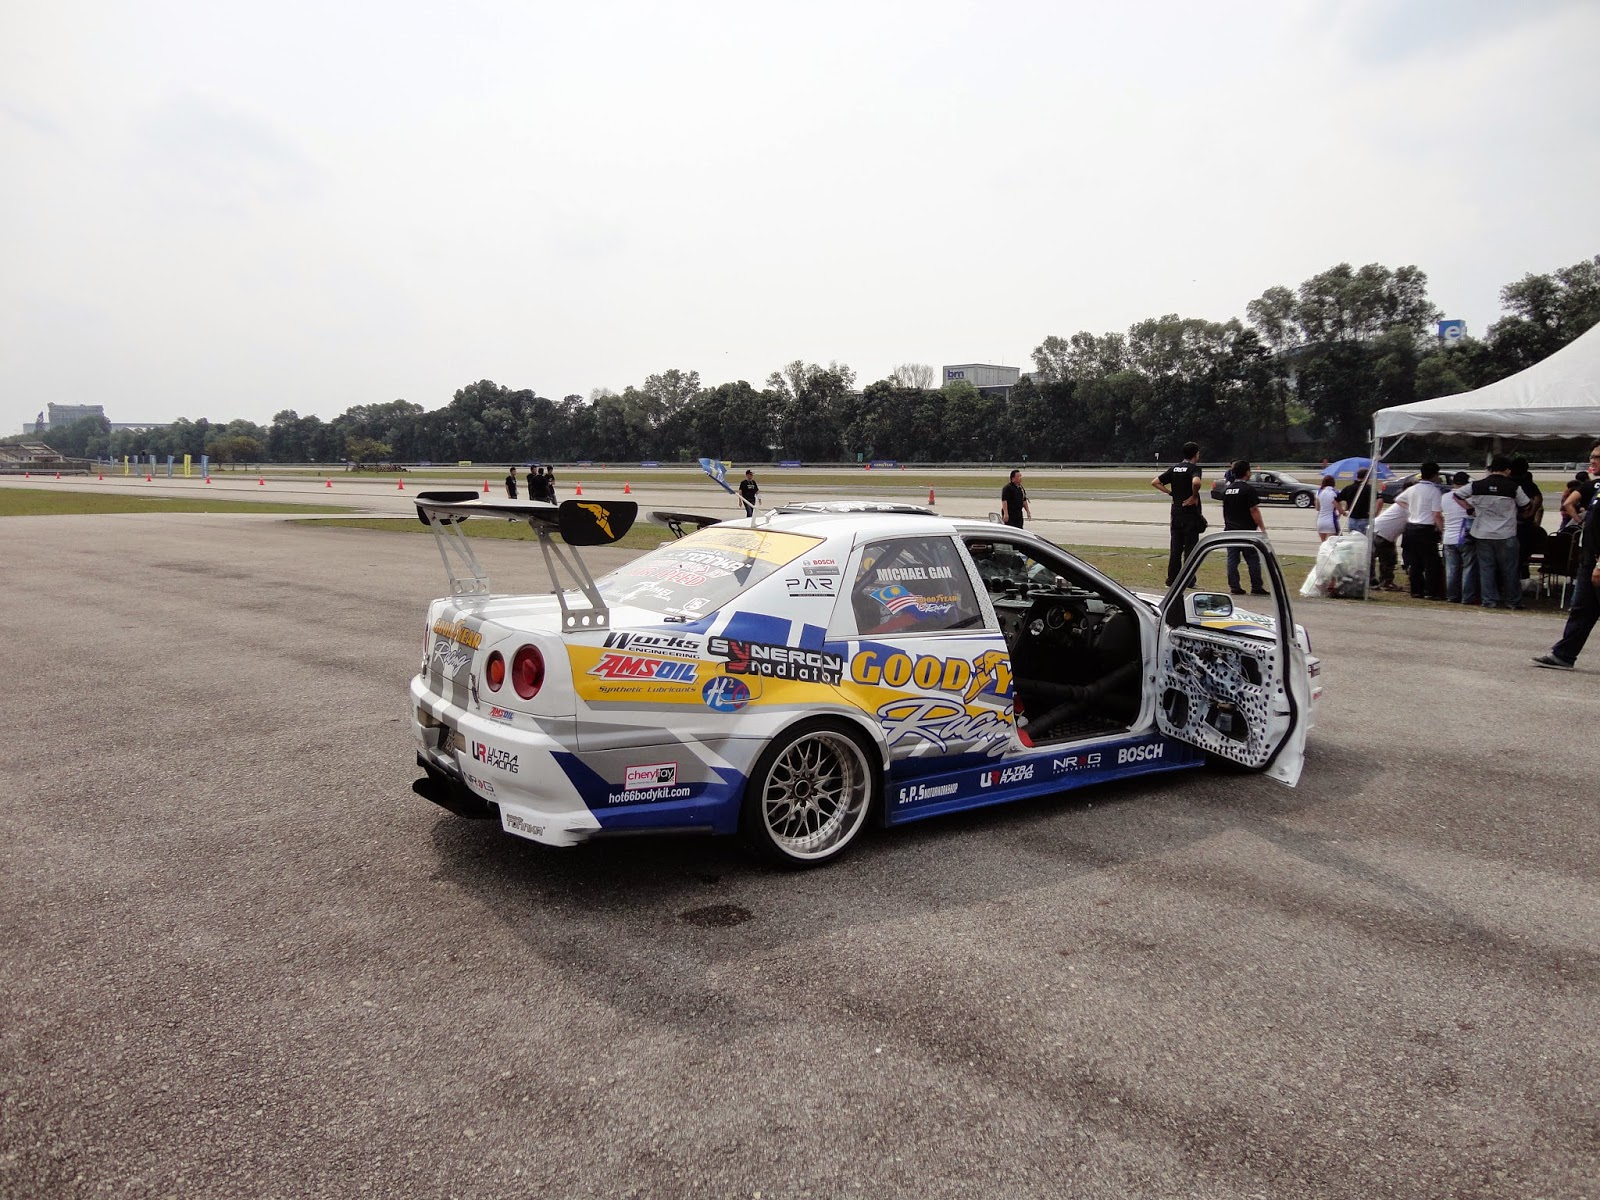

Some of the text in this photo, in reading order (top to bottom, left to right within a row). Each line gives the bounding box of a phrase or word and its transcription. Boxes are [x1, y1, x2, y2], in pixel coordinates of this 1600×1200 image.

[876, 566, 952, 581] MICHAEL GAN
[785, 578, 834, 590] PAR
[603, 632, 701, 651] Works
[629, 646, 700, 659] ENGINEERING
[711, 638, 841, 671] SYNERGY
[594, 653, 699, 682] AMSOIL
[751, 661, 842, 684] radiator
[598, 685, 696, 694] Synthetic Lubricants
[488, 706, 514, 721] AMSOIL
[487, 746, 519, 763] ULTRA
[1117, 743, 1164, 764] BOSCH
[486, 758, 520, 774] RACING
[1002, 764, 1034, 775] ULTRA
[999, 770, 1034, 785] RACING
[608, 786, 691, 804] hot66bodykit.com
